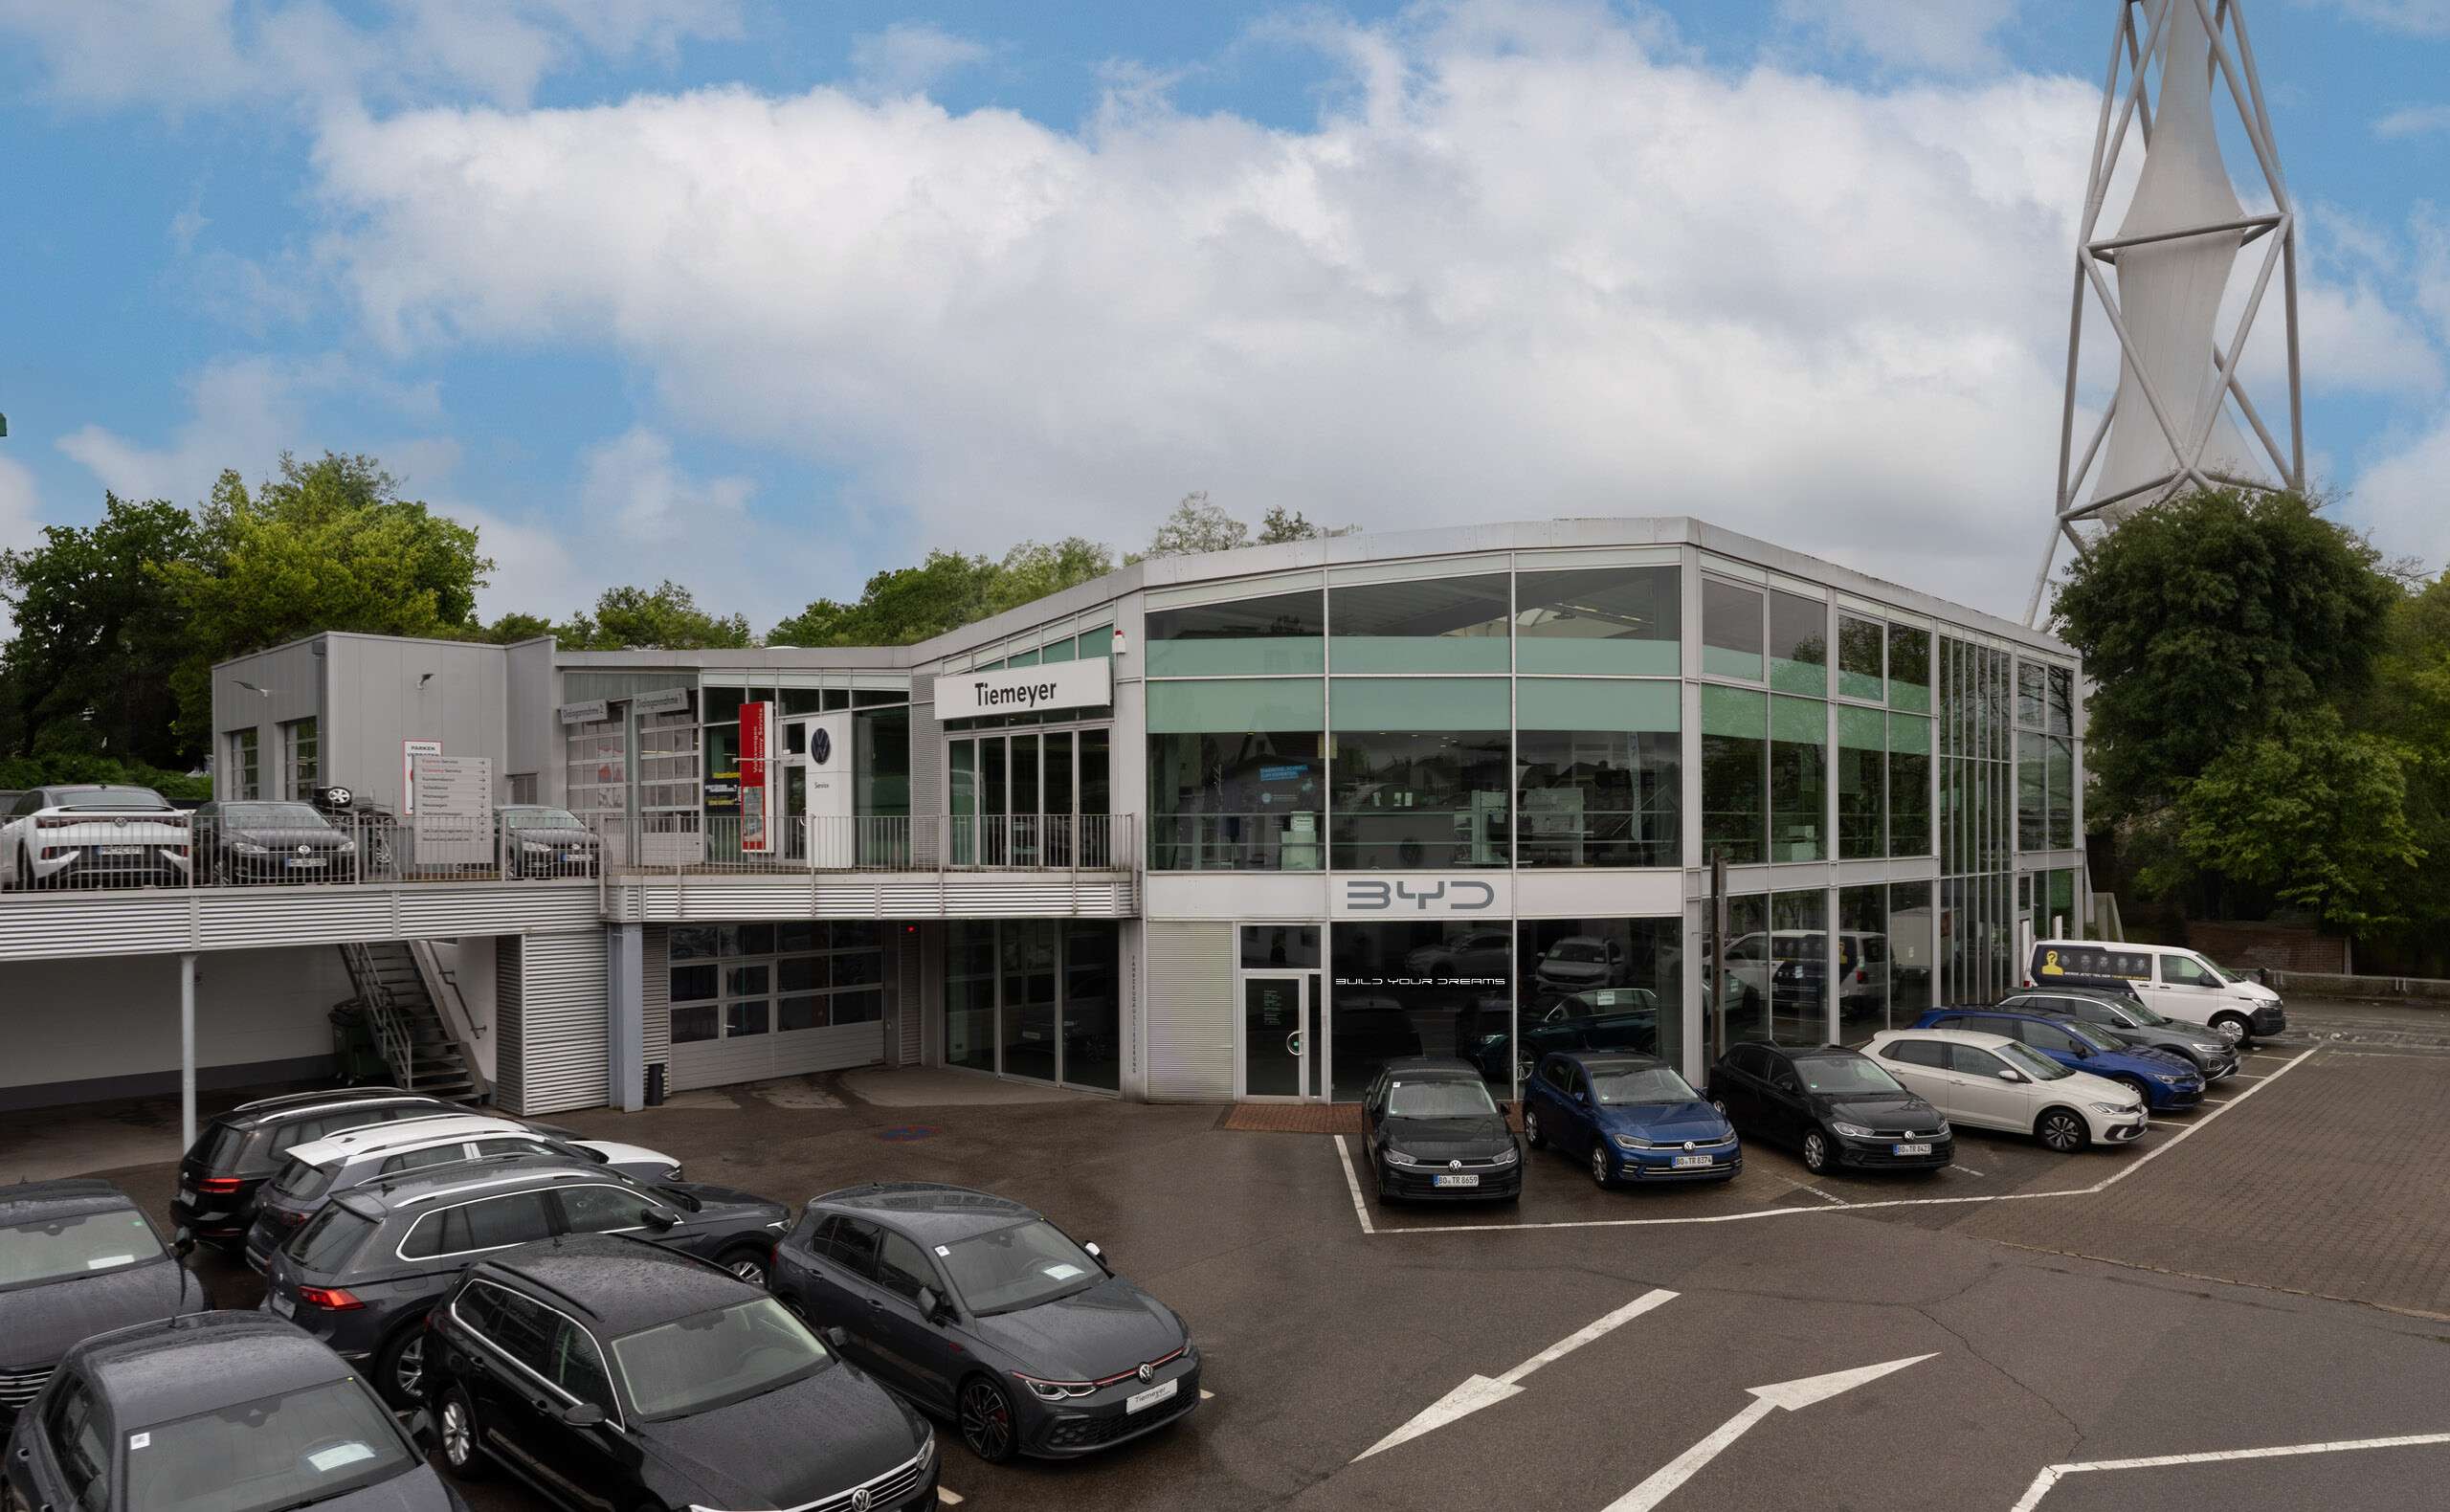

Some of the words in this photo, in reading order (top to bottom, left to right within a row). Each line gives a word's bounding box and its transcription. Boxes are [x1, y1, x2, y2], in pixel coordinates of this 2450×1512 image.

[974, 682, 1057, 707] Tiemeyer
[1348, 881, 1494, 909] BYD
[1460, 1176, 1478, 1185] 8659
[1135, 1387, 1166, 1403] Tiemeyer
